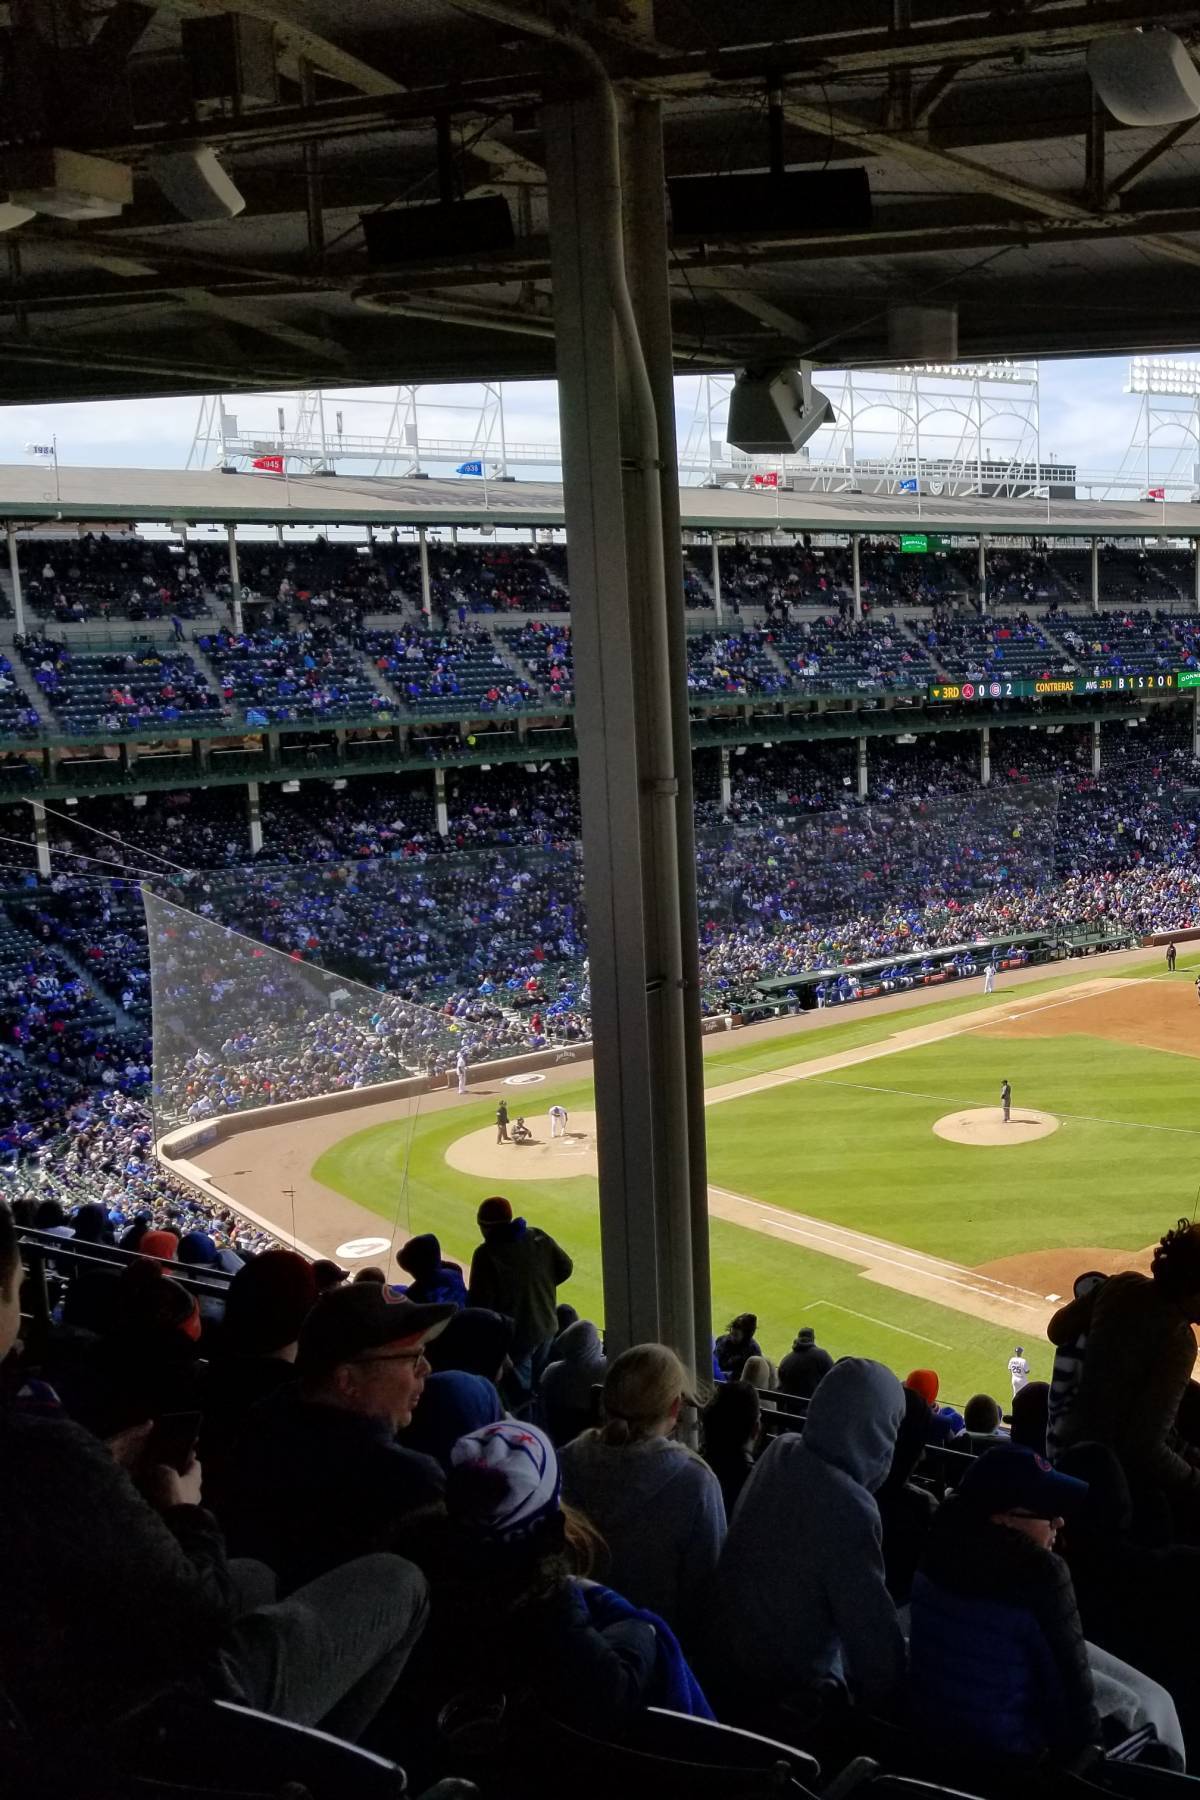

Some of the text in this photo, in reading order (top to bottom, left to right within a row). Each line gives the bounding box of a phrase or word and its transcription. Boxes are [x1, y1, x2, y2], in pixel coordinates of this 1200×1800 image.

[1035, 681, 1074, 692] CONTRERAS
[1085, 681, 1097, 689] AVG
[1118, 678, 1125, 688] B
[1129, 677, 1134, 688] 1
[1138, 676, 1144, 687] S
[1147, 676, 1153, 687] 2
[1166, 675, 1172, 686] 0
[943, 687, 959, 698] 3RD
[978, 685, 985, 697] 0
[1006, 683, 1012, 695] 2
